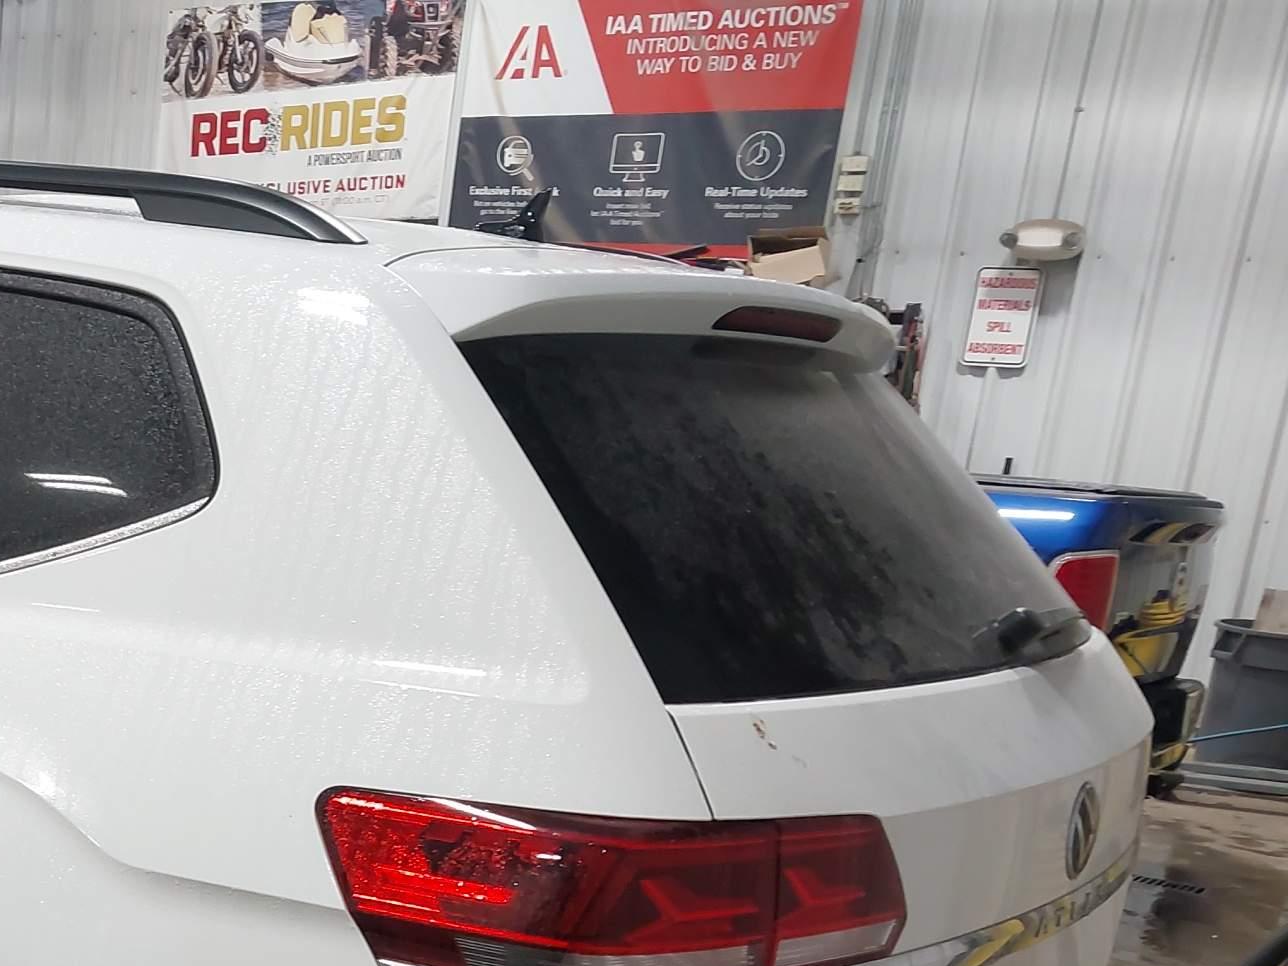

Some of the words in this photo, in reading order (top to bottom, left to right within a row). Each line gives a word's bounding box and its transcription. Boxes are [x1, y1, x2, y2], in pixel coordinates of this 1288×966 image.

[605, 15, 643, 35] IAA
[649, 10, 712, 32] TIMED
[626, 32, 749, 55] INTRODUCING
[753, 33, 768, 48] A
[773, 30, 820, 48] NEW
[636, 56, 675, 76] WAY
[679, 56, 702, 73] TO
[707, 55, 738, 72] BID
[743, 54, 757, 71] &
[762, 52, 802, 70] BUY
[191, 108, 269, 157] REC
[279, 94, 407, 151] RIDES
[367, 148, 402, 162] AUCTION
[335, 174, 407, 193] AUCTION
